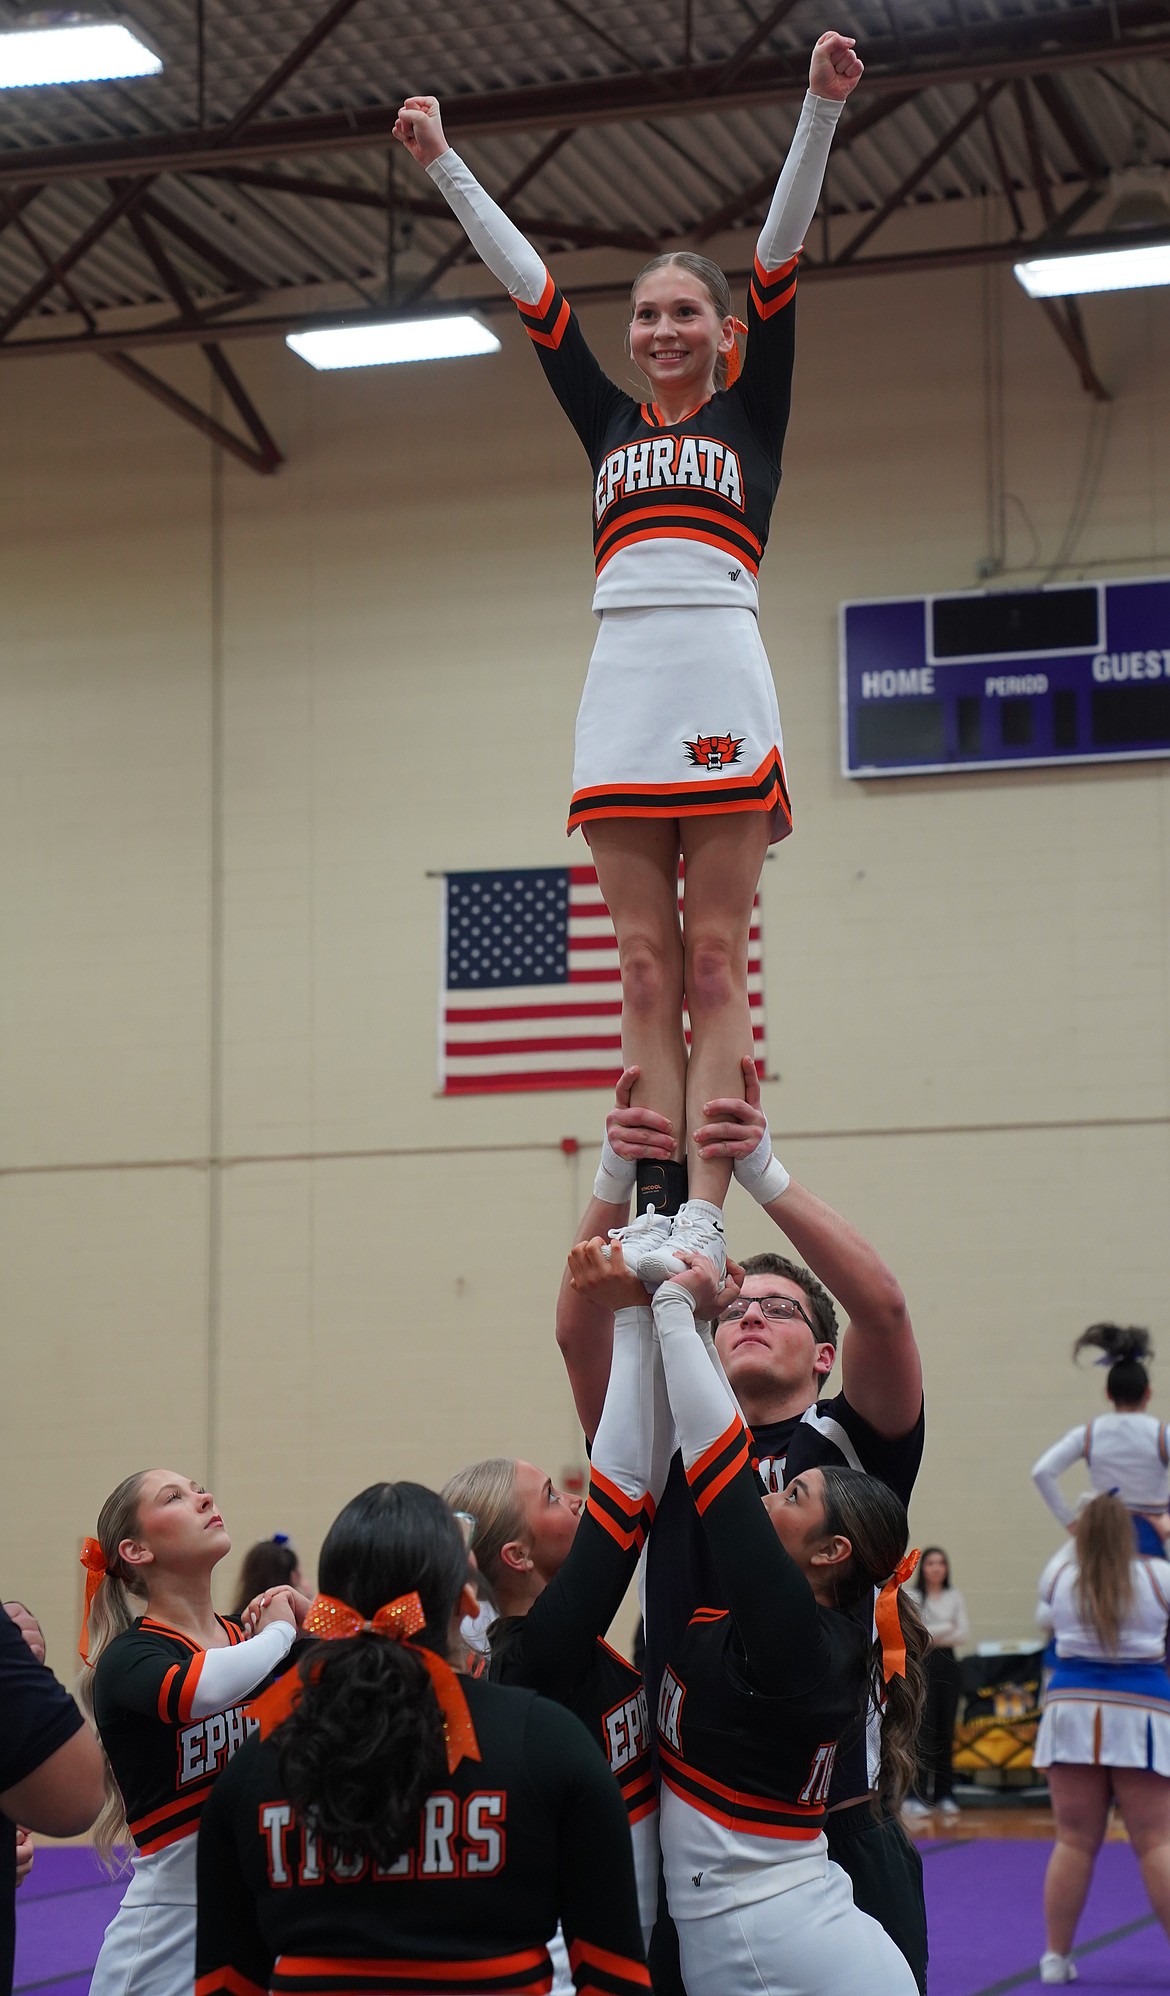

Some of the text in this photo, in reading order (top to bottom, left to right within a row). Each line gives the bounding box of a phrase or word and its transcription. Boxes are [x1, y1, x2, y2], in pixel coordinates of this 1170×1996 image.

[594, 437, 743, 523] EPHRATA
[861, 667, 935, 699] HOME
[985, 673, 1049, 697] PERIOD
[263, 1796, 502, 1883] TIRS
